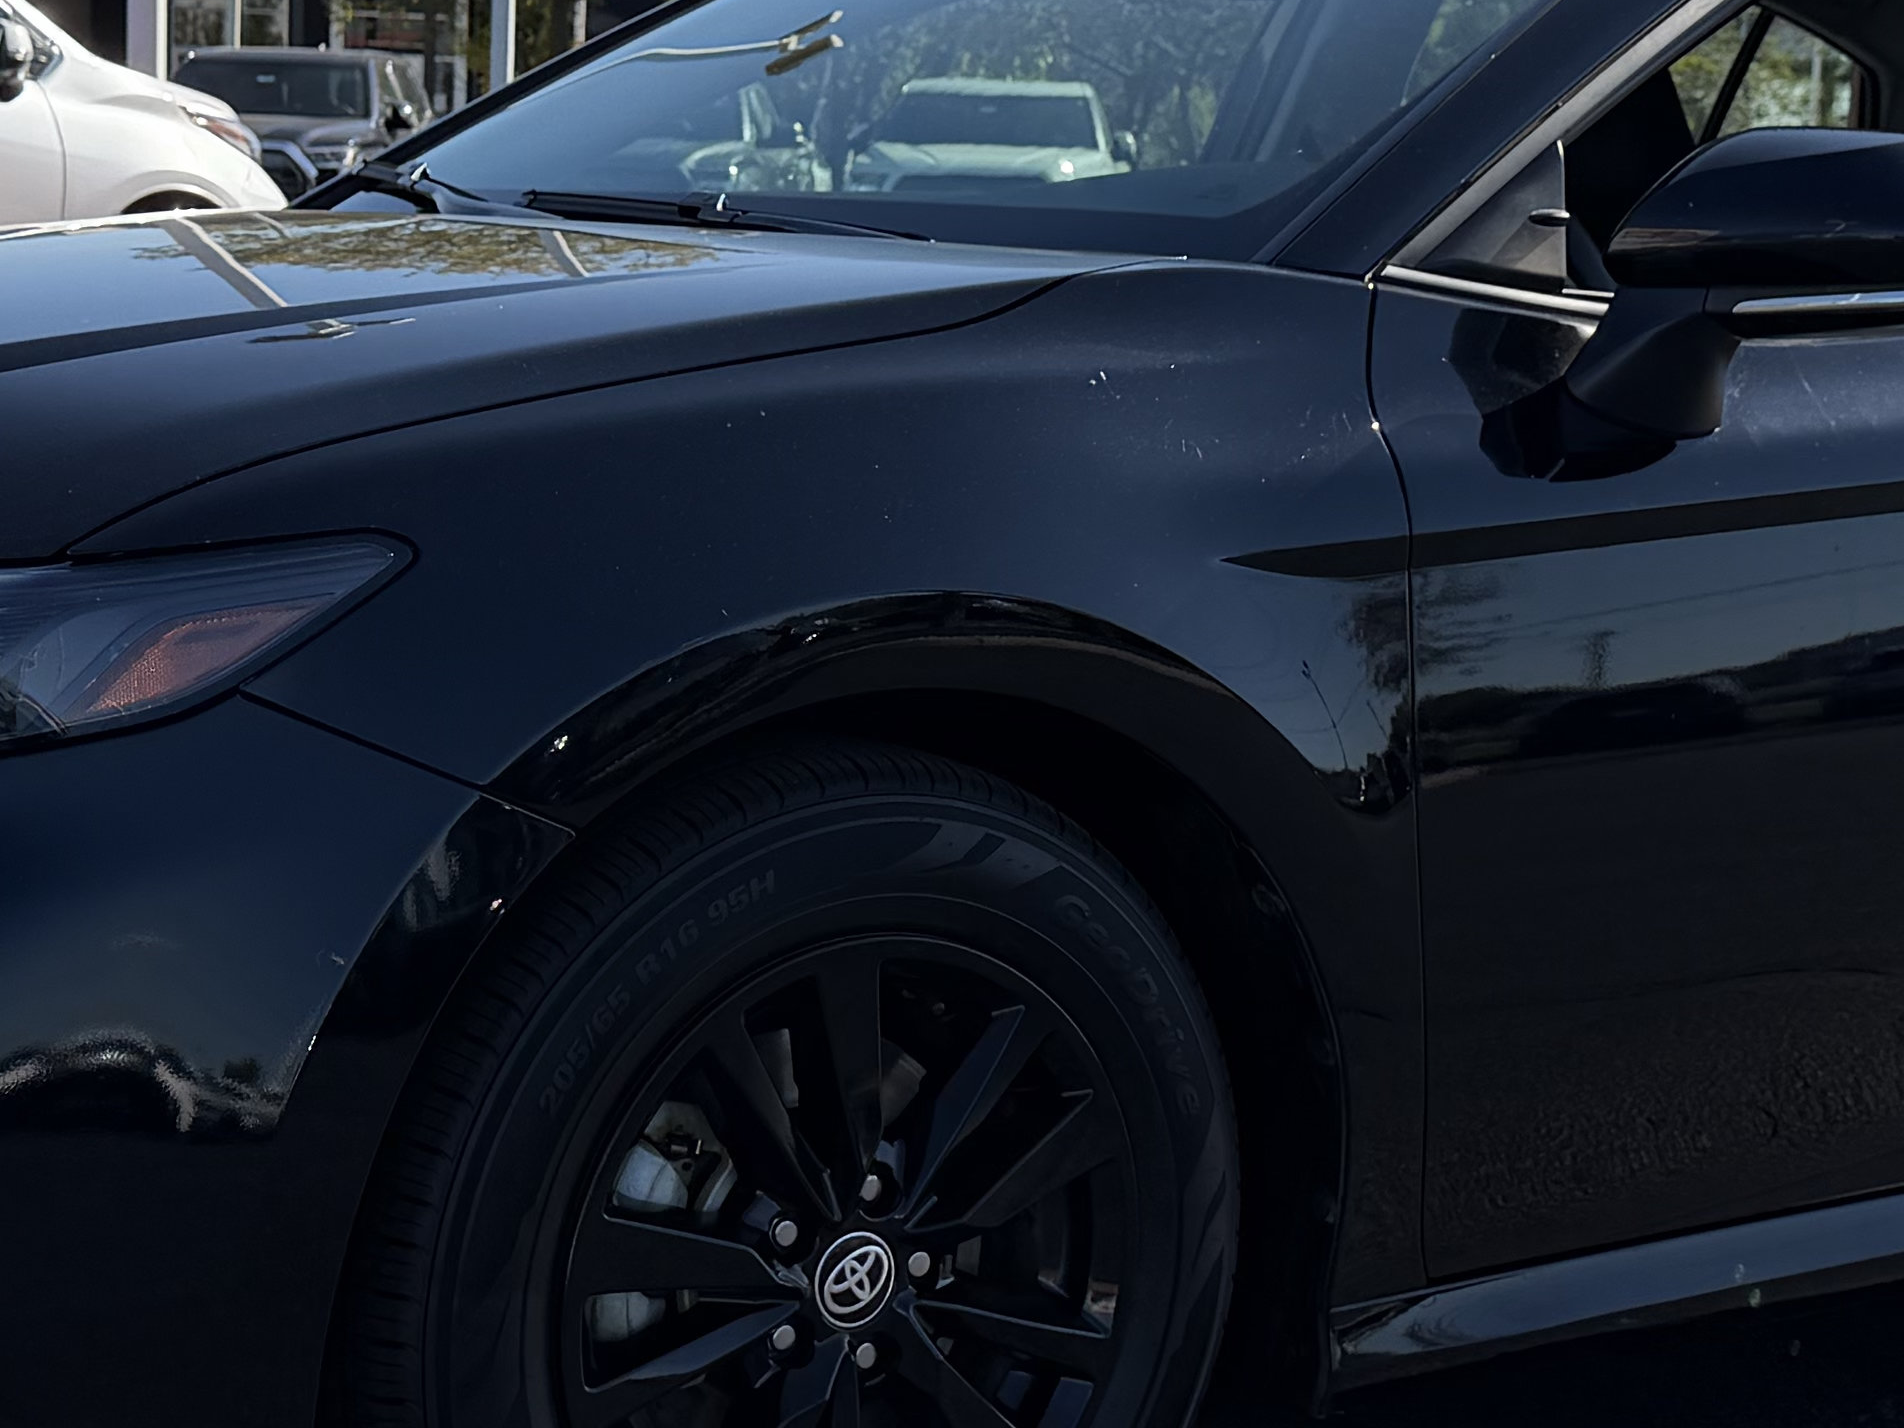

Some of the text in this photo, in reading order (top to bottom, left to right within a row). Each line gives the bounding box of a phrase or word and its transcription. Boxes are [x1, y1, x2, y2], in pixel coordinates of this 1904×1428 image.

[539, 868, 776, 1115] 205/65 R16 95H
